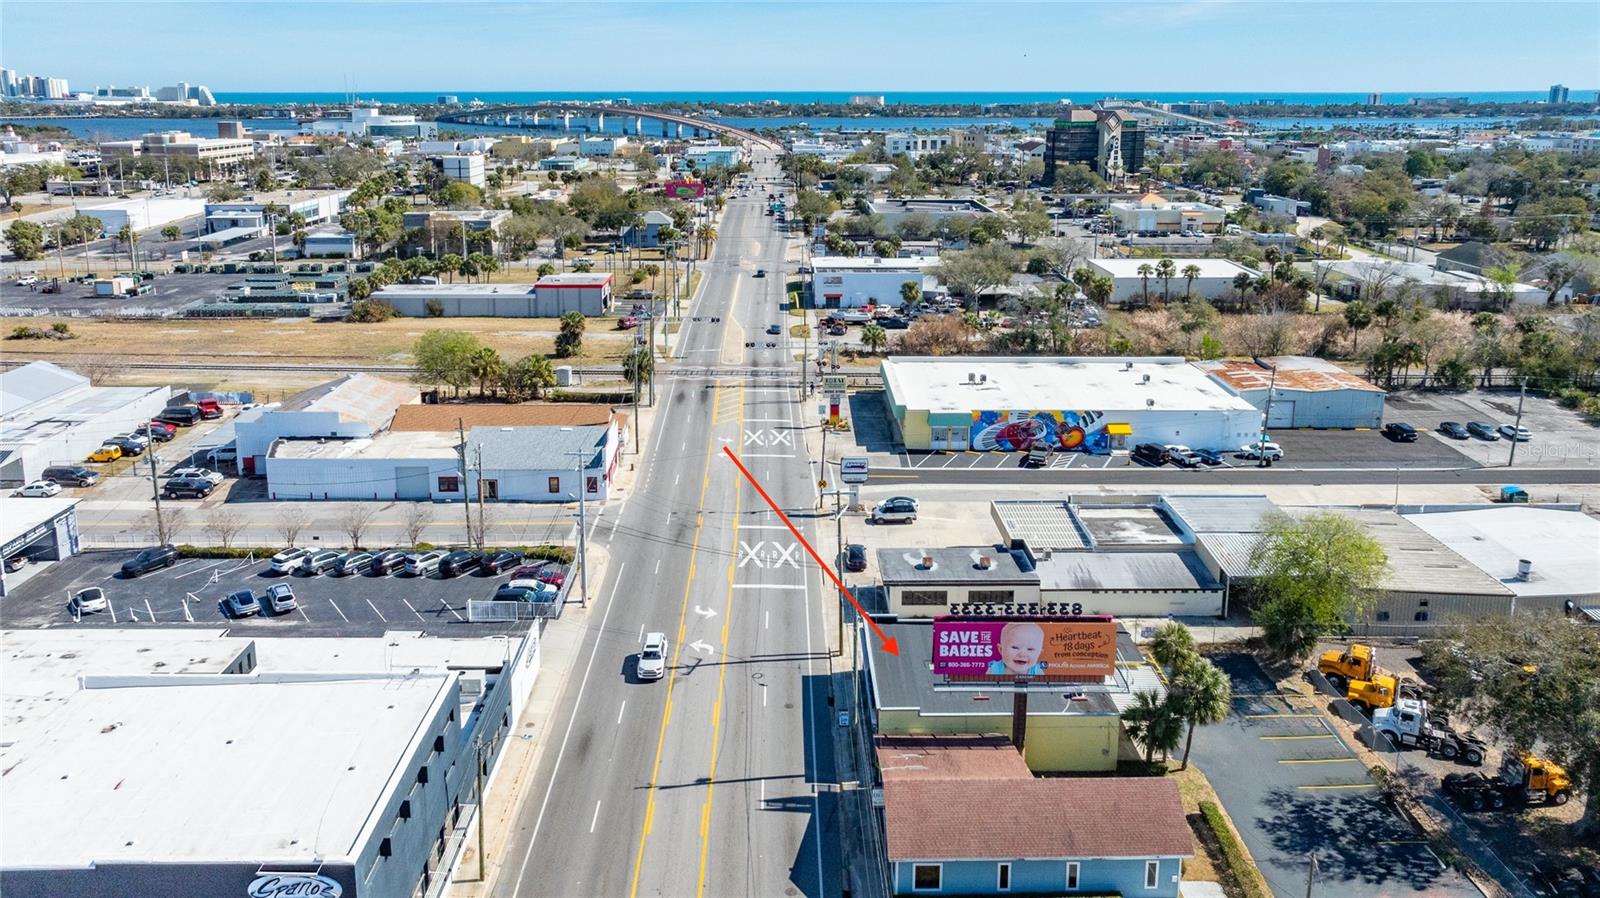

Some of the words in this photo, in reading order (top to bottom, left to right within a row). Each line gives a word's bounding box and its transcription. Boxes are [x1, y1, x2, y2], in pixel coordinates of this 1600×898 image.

[940, 630, 979, 643] SAVE
[981, 632, 992, 641] THE
[1055, 631, 1102, 642] Heartbeat
[939, 645, 993, 657] BABIES
[1063, 643, 1073, 651] 18
[1074, 641, 1095, 652] days
[1072, 651, 1108, 659] conception
